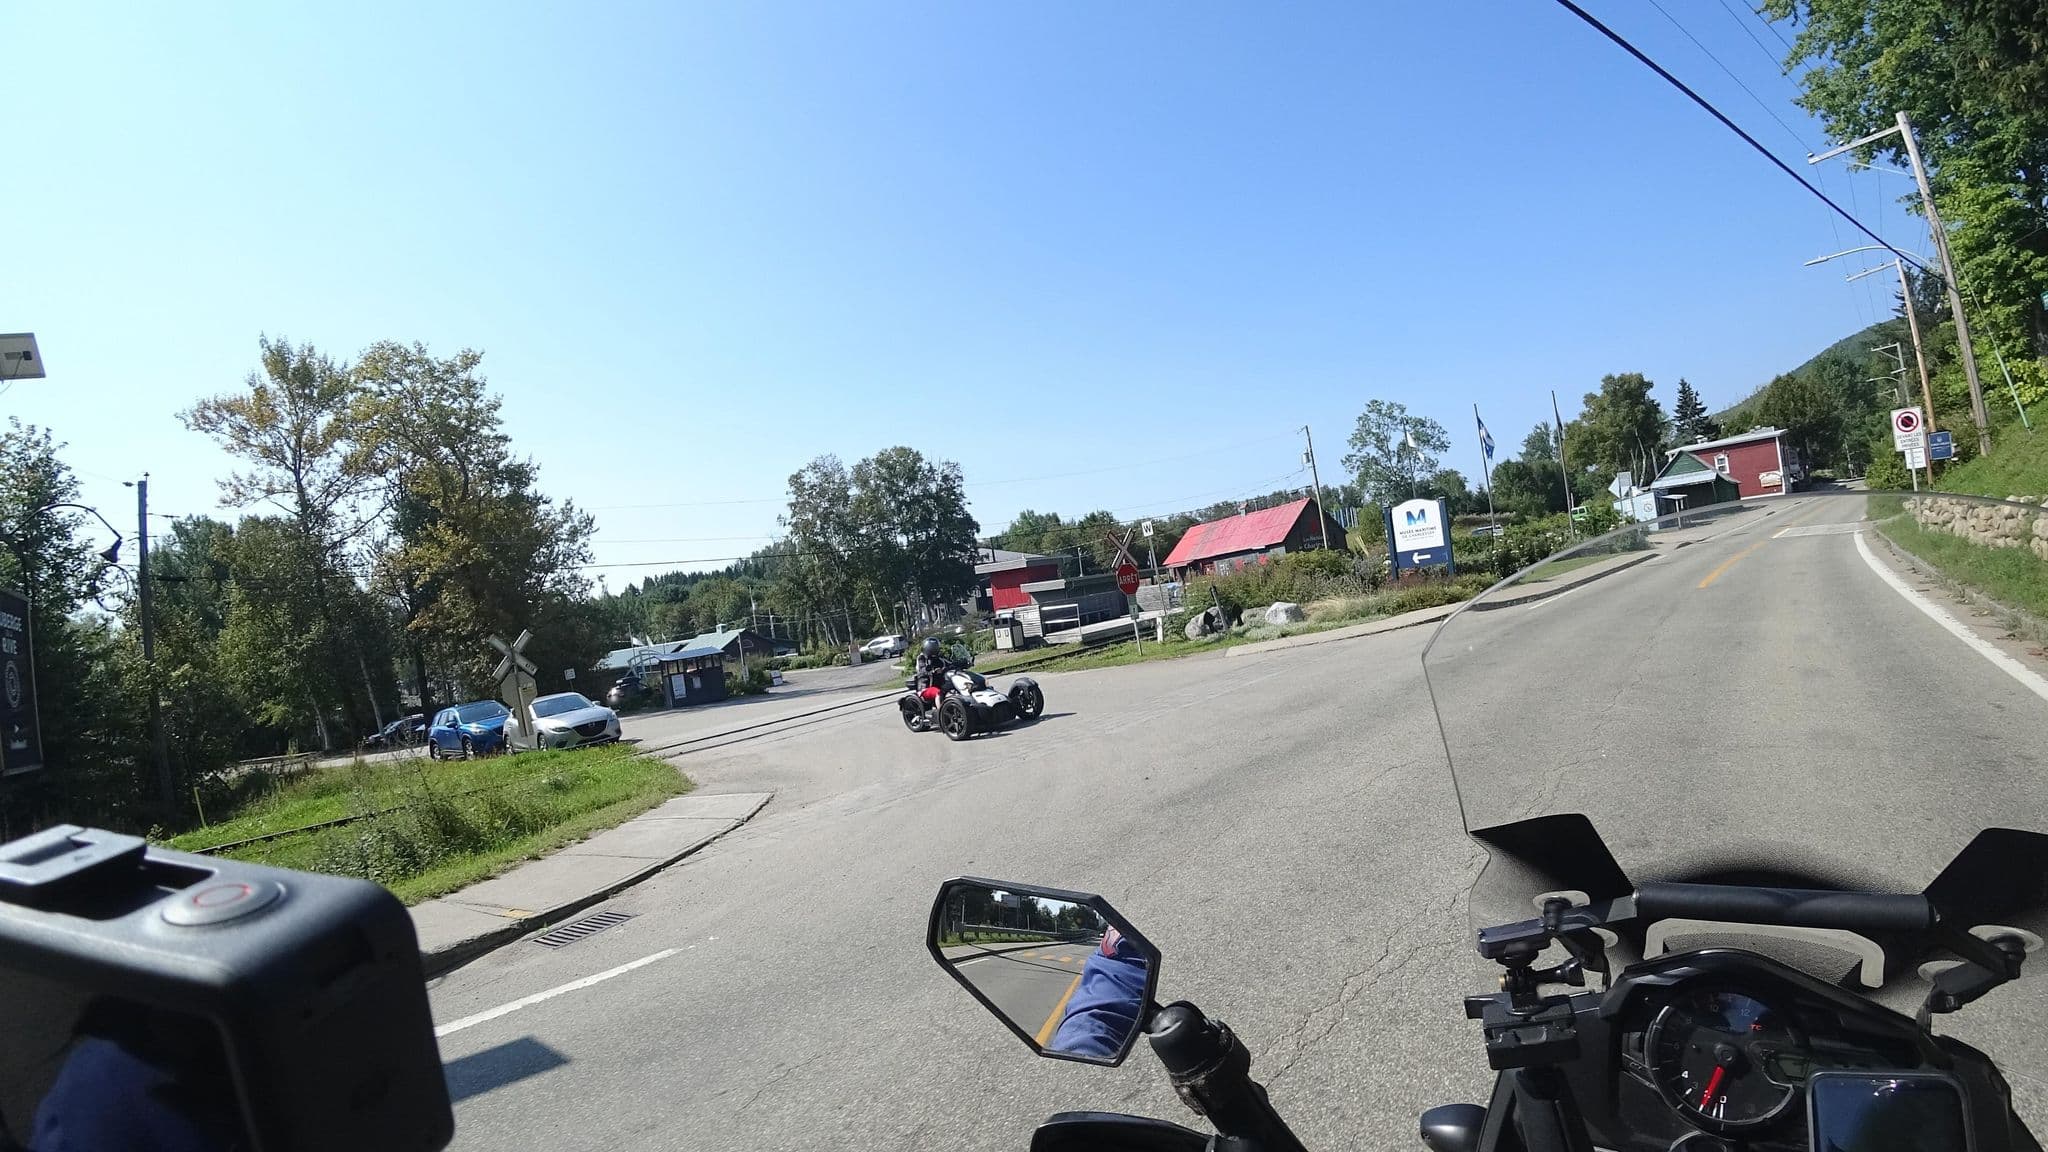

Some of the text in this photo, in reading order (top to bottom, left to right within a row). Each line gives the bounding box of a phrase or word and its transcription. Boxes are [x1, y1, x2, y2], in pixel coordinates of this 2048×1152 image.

[1406, 508, 1427, 526] M
[1143, 523, 1151, 533] W
[1119, 572, 1138, 585] ARRÊT
[1681, 1070, 1688, 1079] 4
